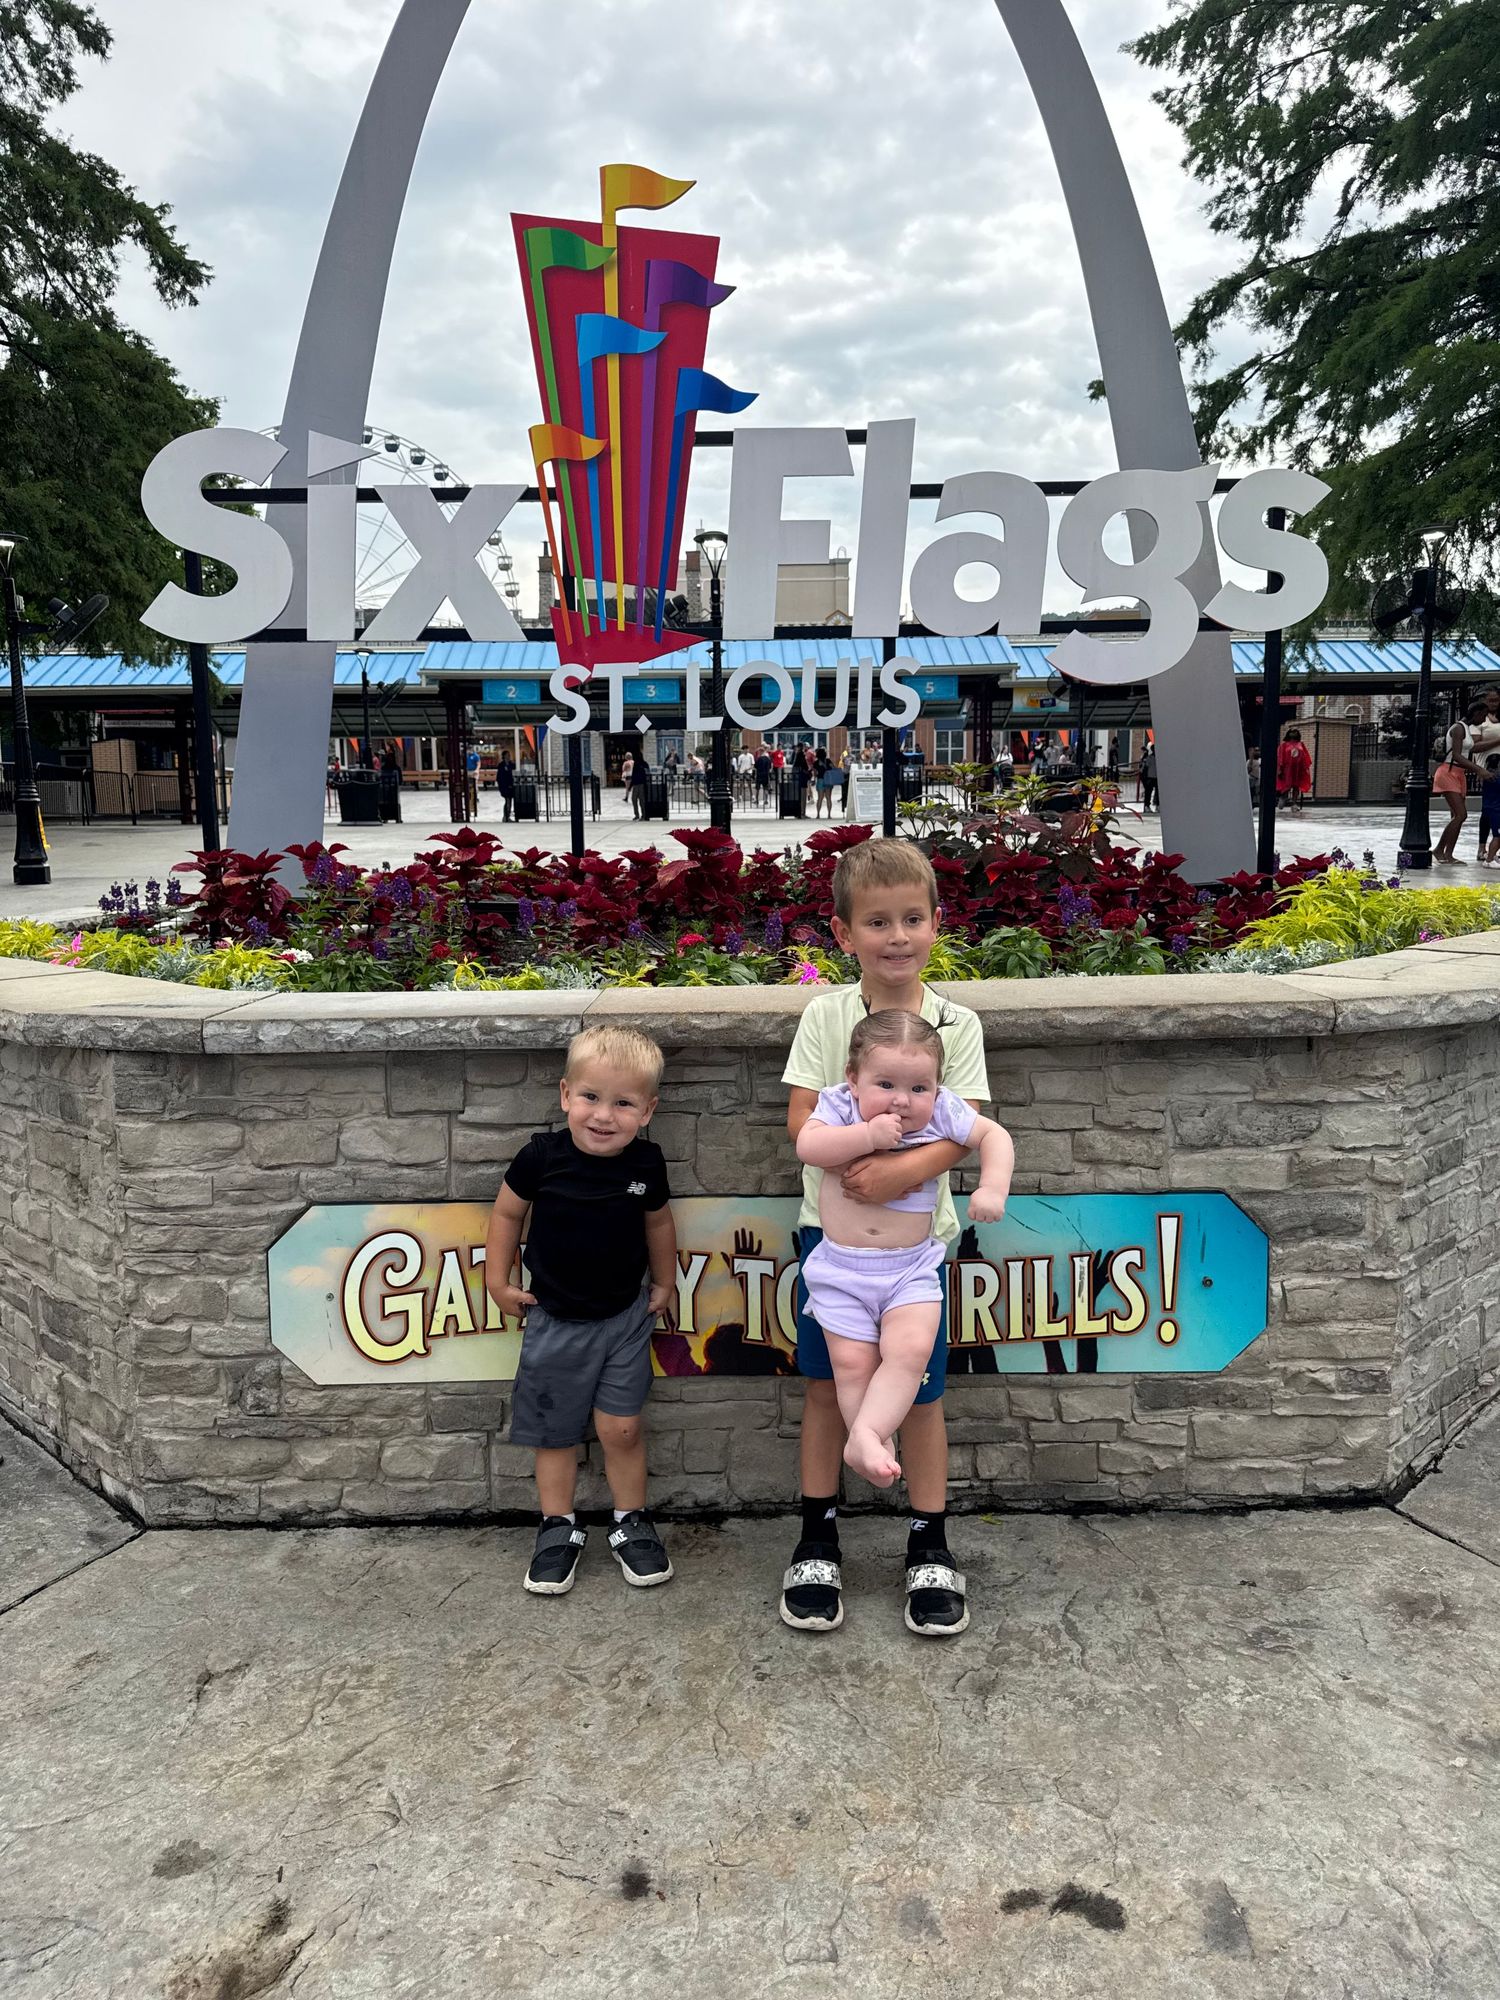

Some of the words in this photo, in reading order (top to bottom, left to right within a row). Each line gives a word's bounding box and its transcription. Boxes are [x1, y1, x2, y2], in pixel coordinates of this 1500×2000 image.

[140, 427, 529, 643] Six
[722, 418, 1333, 684] Flags
[506, 685, 517, 698] 2
[546, 662, 653, 735] ST.
[686, 656, 922, 731] LOUIS
[646, 684, 656, 697] 3
[925, 682, 935, 694] 5
[608, 1529, 628, 1547] NIKE
